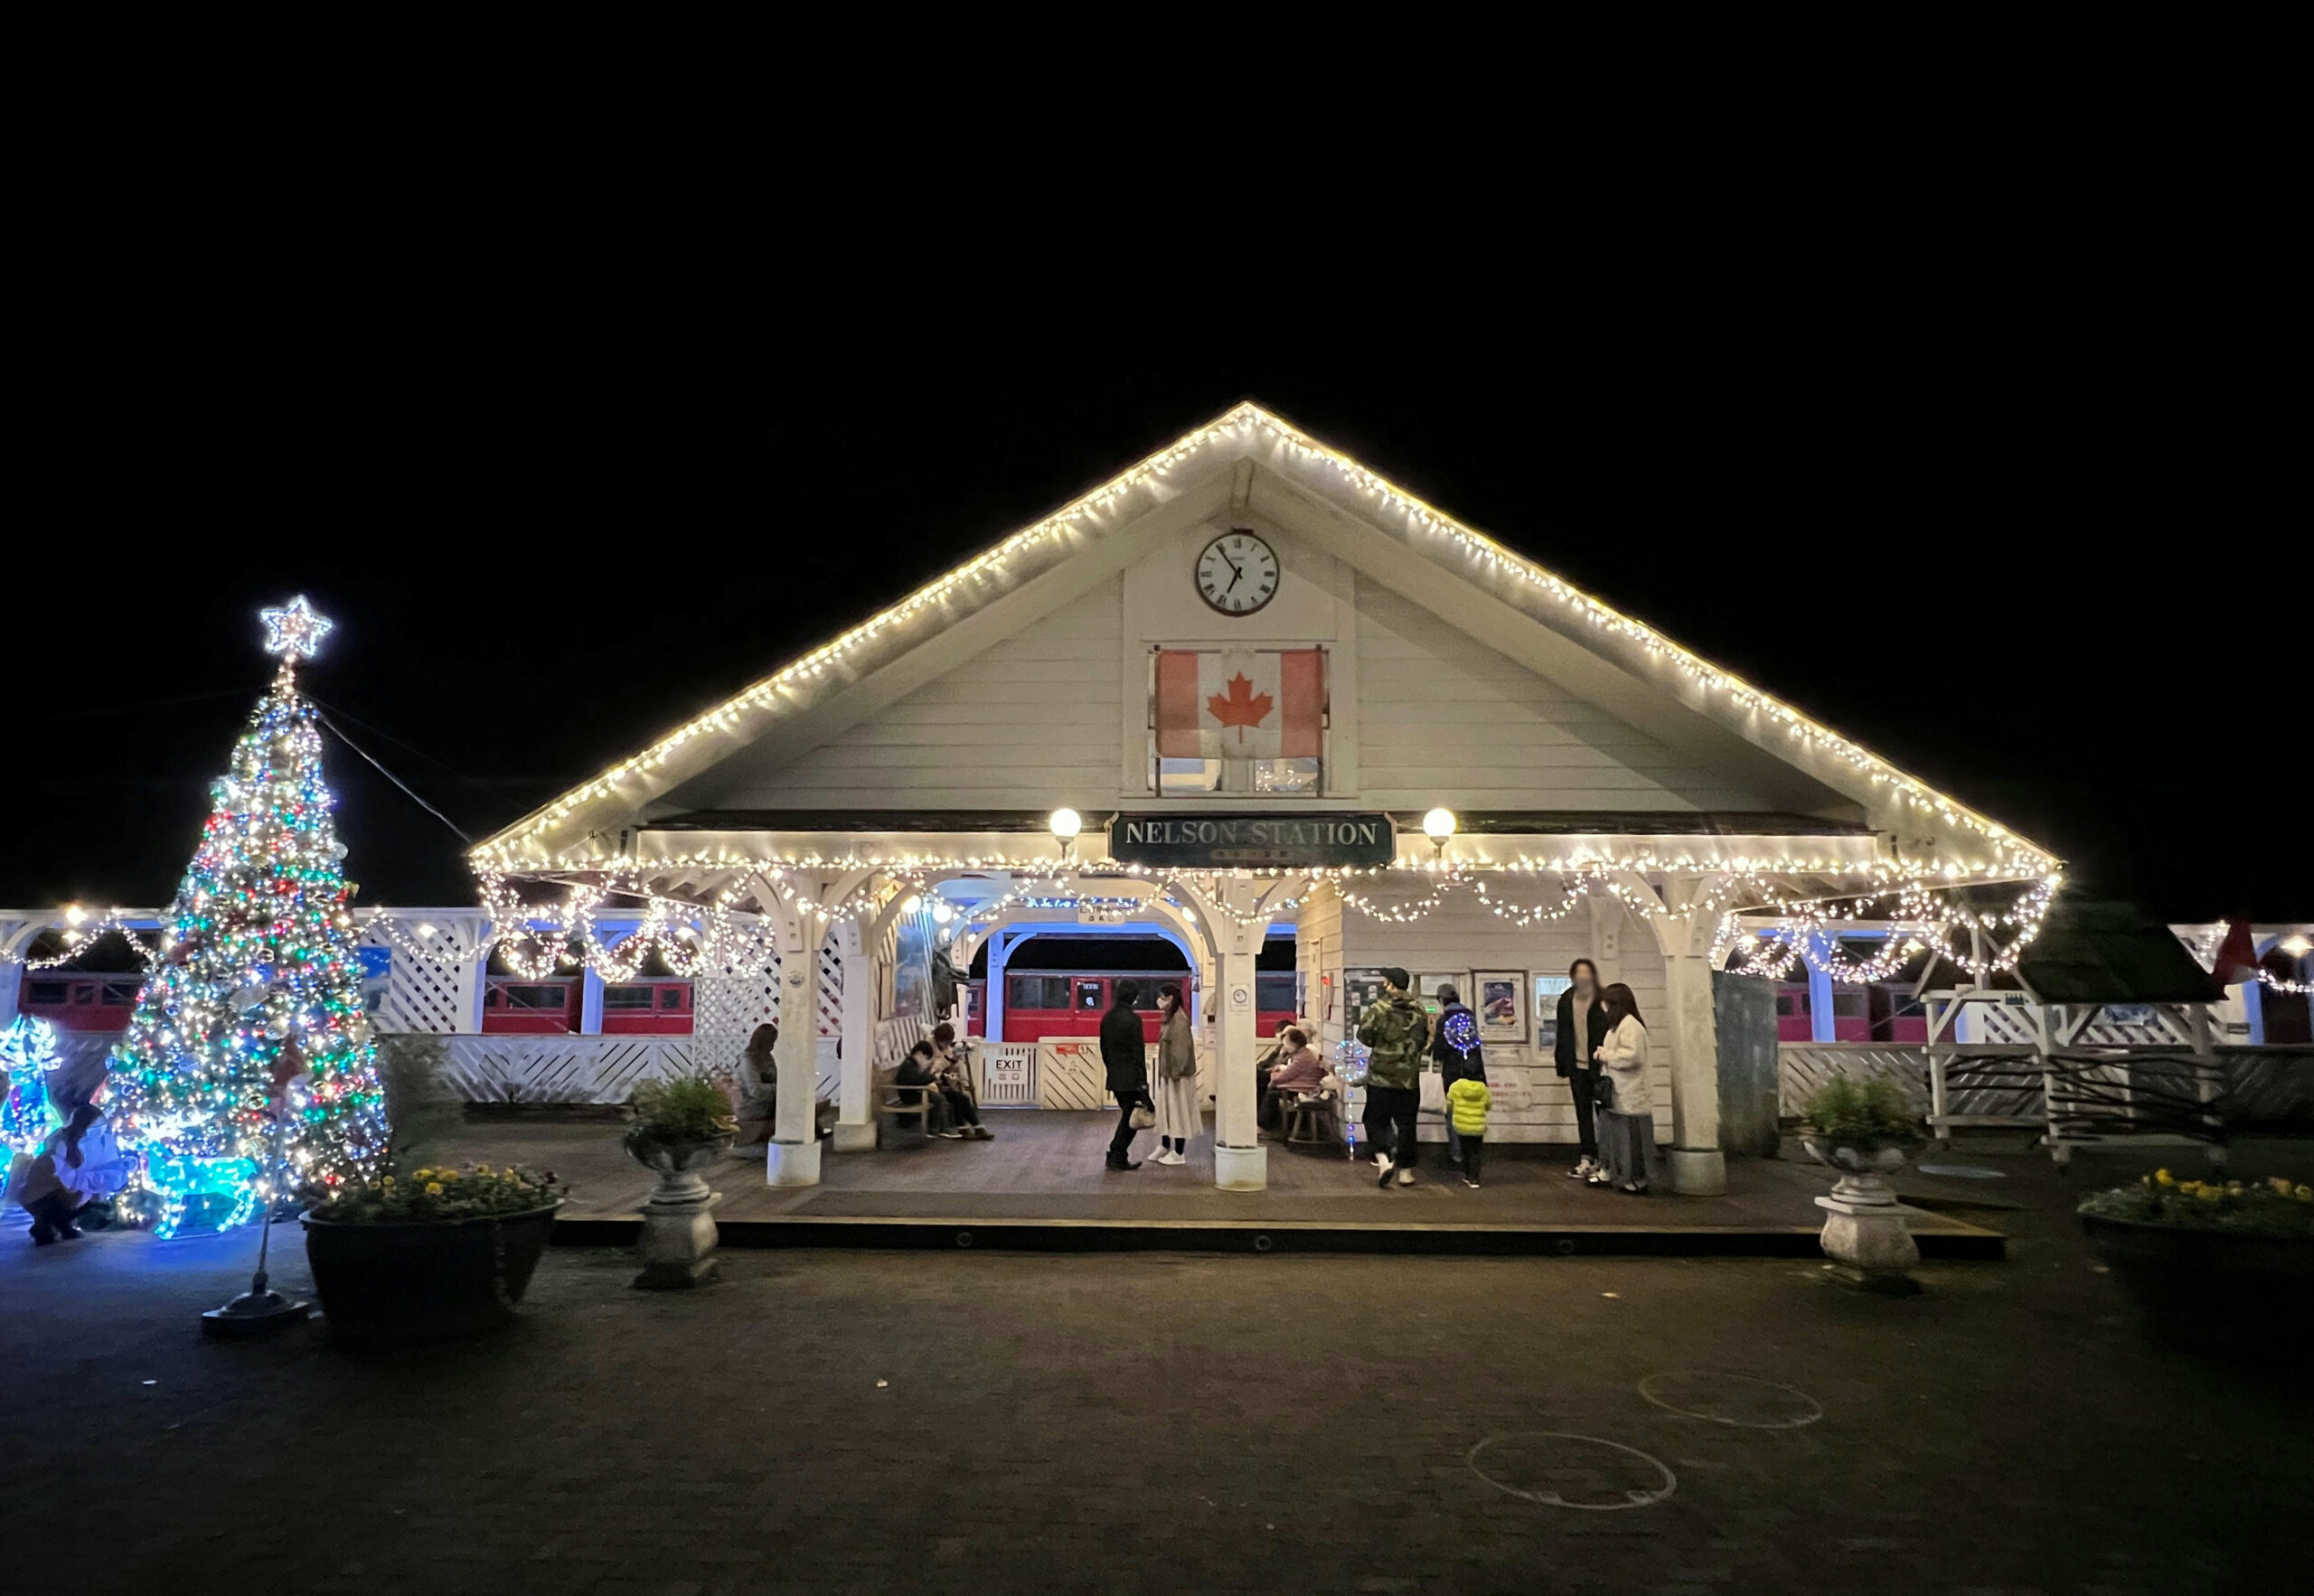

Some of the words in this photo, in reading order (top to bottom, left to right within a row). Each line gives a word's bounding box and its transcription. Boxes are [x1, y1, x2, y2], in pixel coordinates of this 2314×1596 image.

[1125, 821, 1238, 844] NELSON
[1251, 822, 1378, 845] STATION
[995, 1059, 1023, 1069] EXIT
